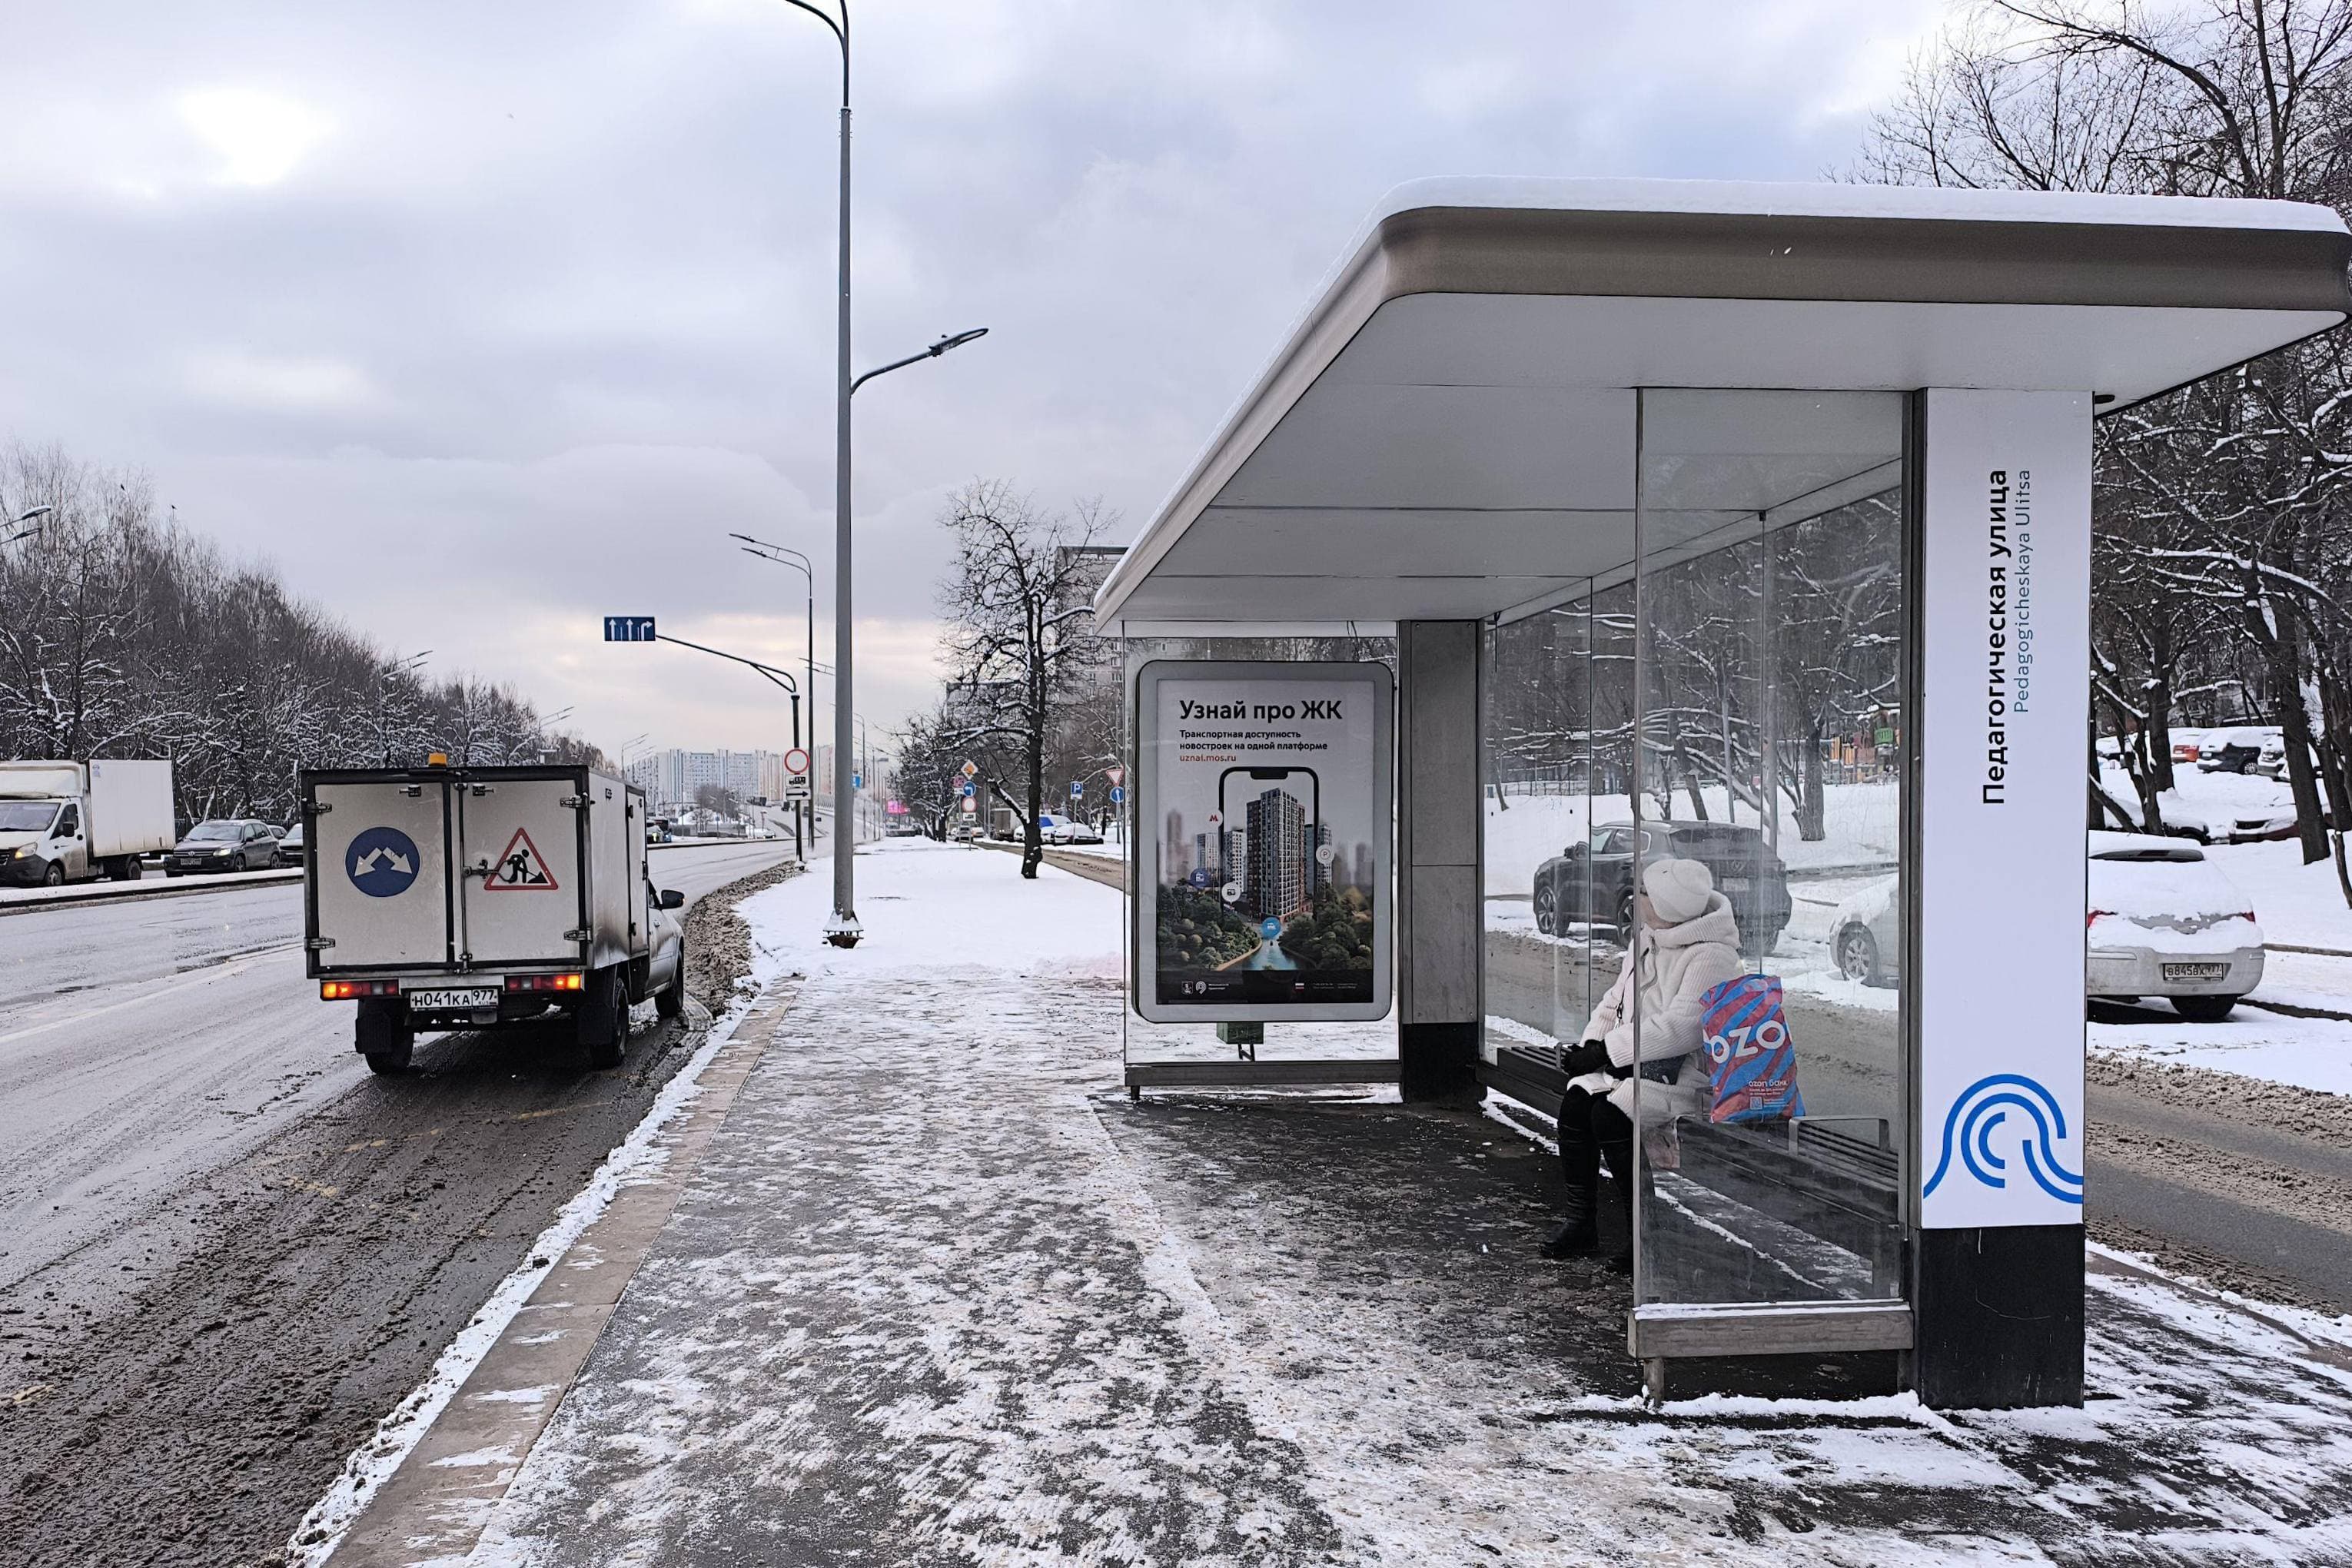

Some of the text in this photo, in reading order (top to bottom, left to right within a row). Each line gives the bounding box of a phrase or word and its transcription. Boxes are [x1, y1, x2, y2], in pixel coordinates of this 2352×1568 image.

[2014, 470, 2033, 712] Pedagogicheskaya Ulitsa
[1982, 470, 2011, 803] Педагогическая улица
[1180, 700, 1343, 723] Узнай про ЖК
[1180, 730, 1301, 739] Транспортная доступность
[1247, 742, 1274, 751] одной
[1277, 742, 1327, 751] платформе
[473, 990, 494, 1001] 977
